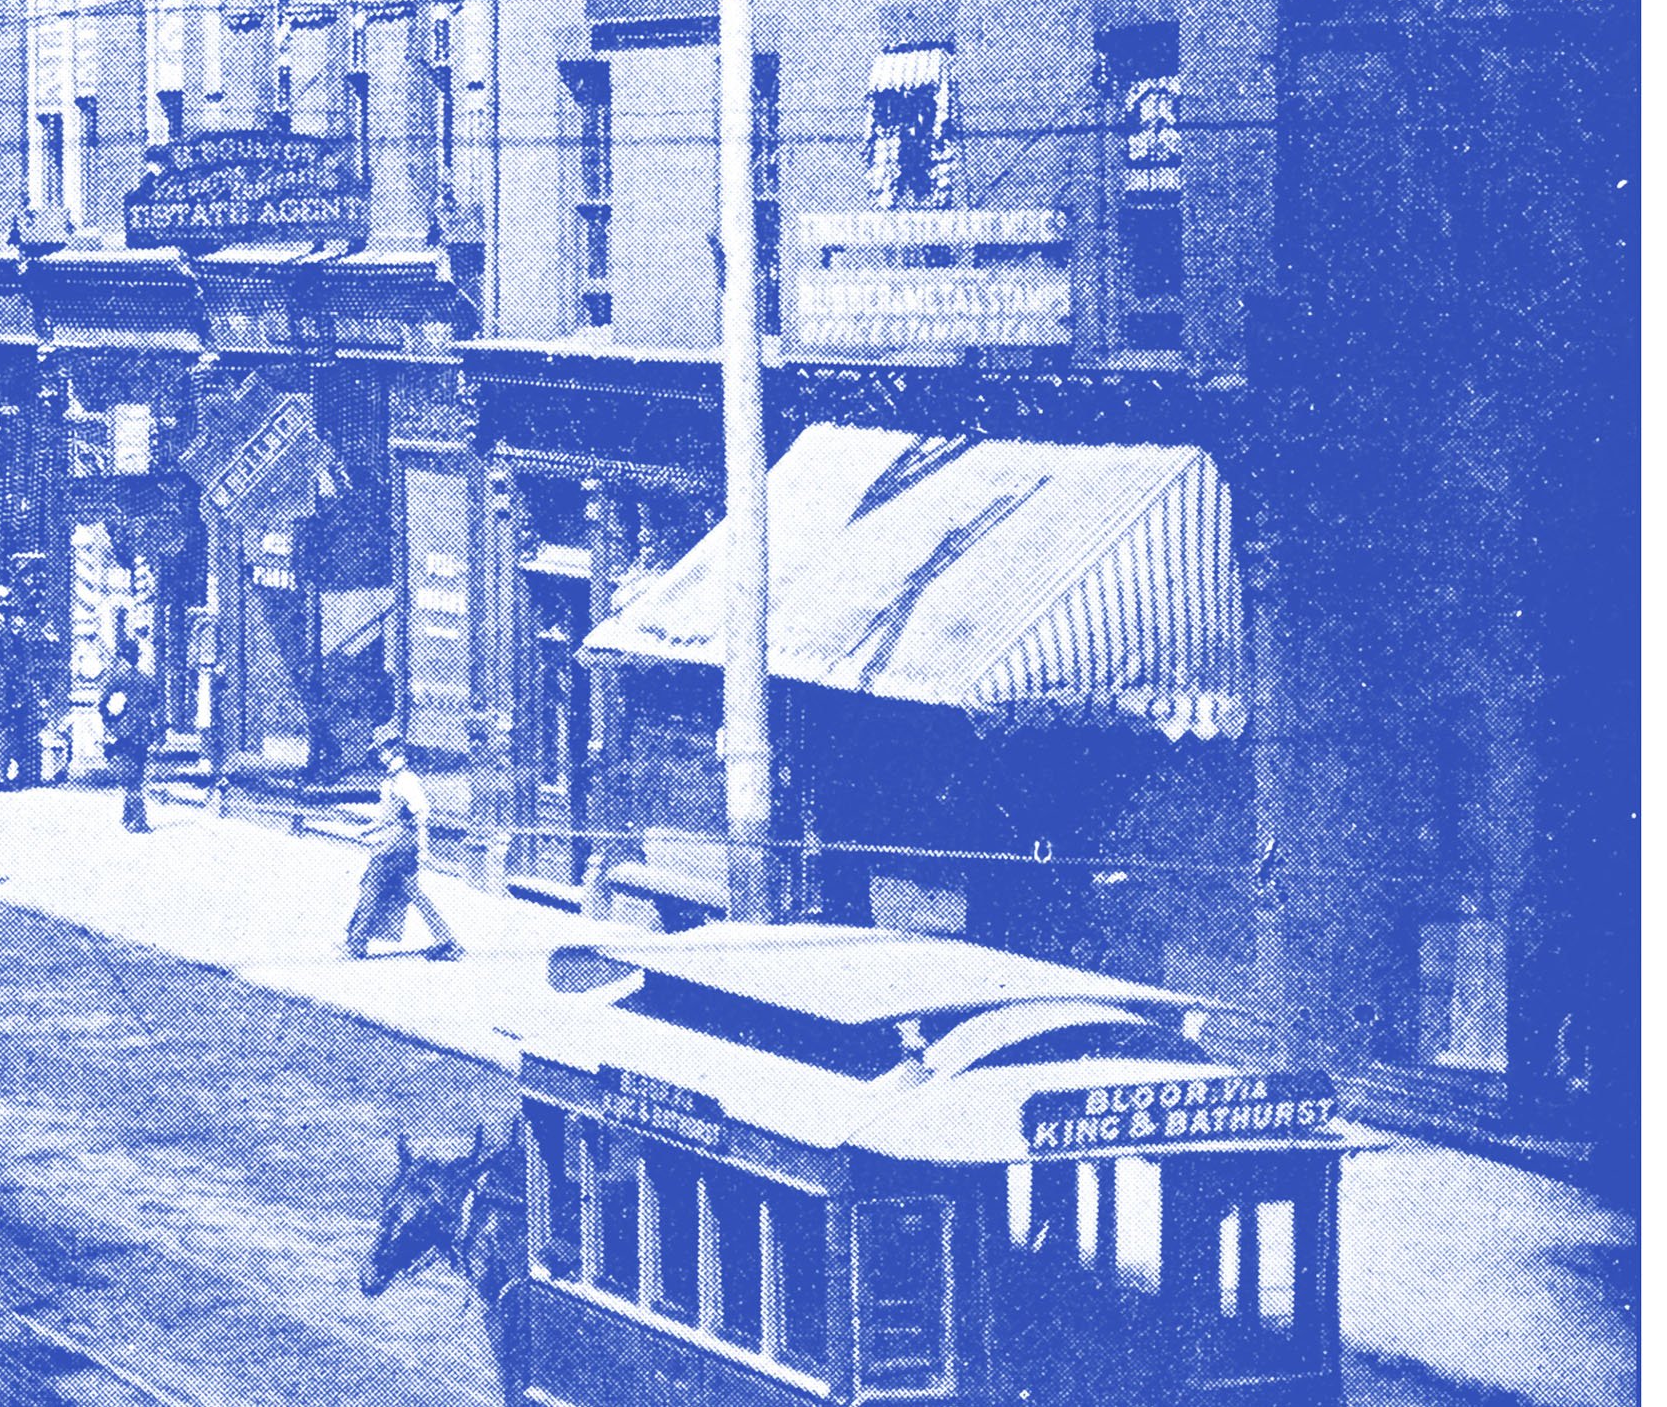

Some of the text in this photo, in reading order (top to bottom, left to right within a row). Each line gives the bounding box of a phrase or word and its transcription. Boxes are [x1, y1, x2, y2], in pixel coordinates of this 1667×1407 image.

[129, 196, 366, 228] ESTATE AGENT
[1084, 1078, 1268, 1115] BLOOR VIA
[1033, 1097, 1334, 1149] KING & BATHURST
